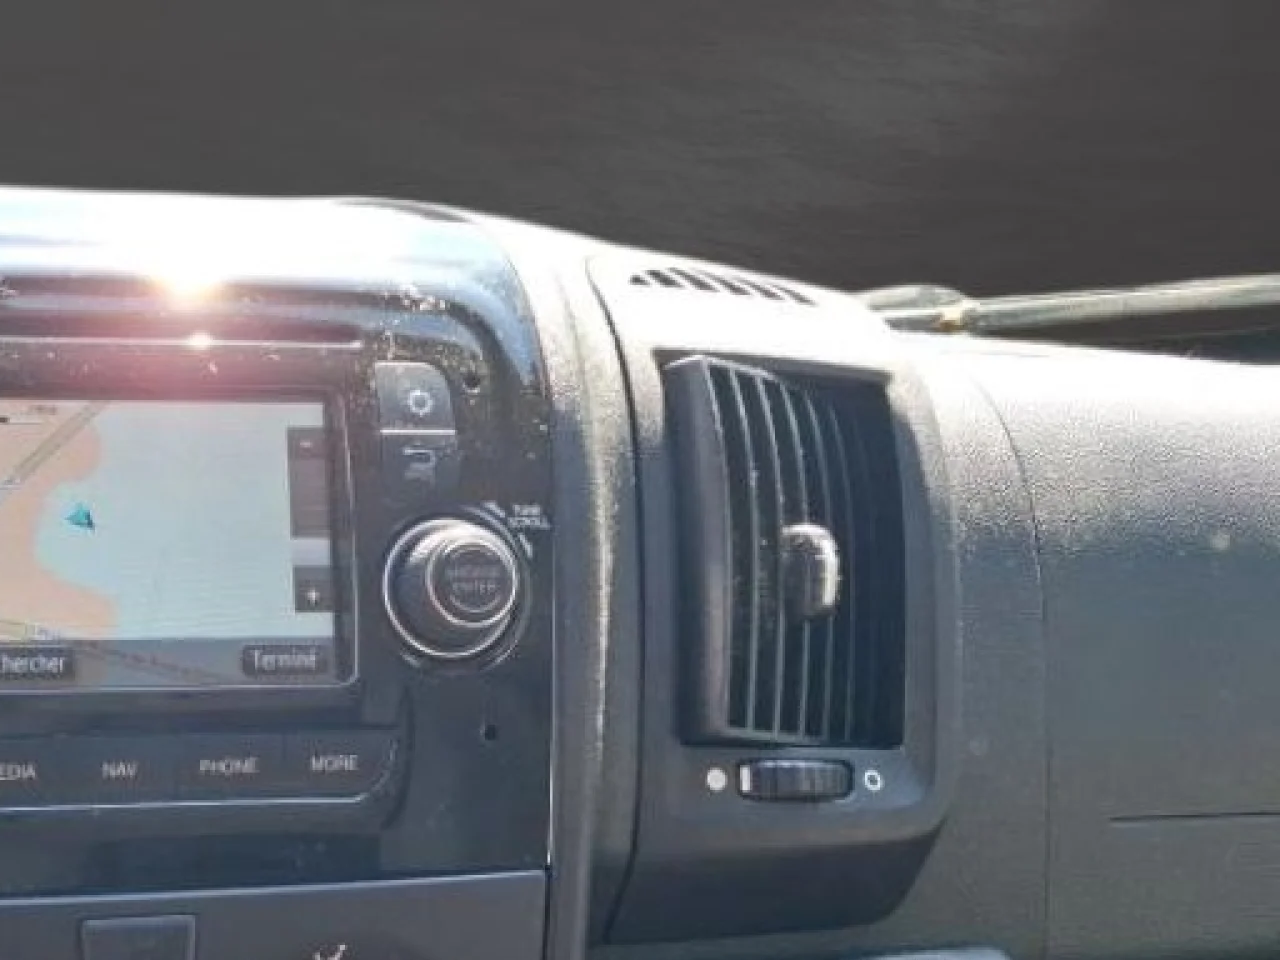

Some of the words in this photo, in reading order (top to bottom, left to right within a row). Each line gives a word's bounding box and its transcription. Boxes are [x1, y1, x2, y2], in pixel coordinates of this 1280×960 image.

[101, 760, 139, 779] NAV
[199, 756, 259, 775] PHONE
[311, 754, 359, 772] MORE
